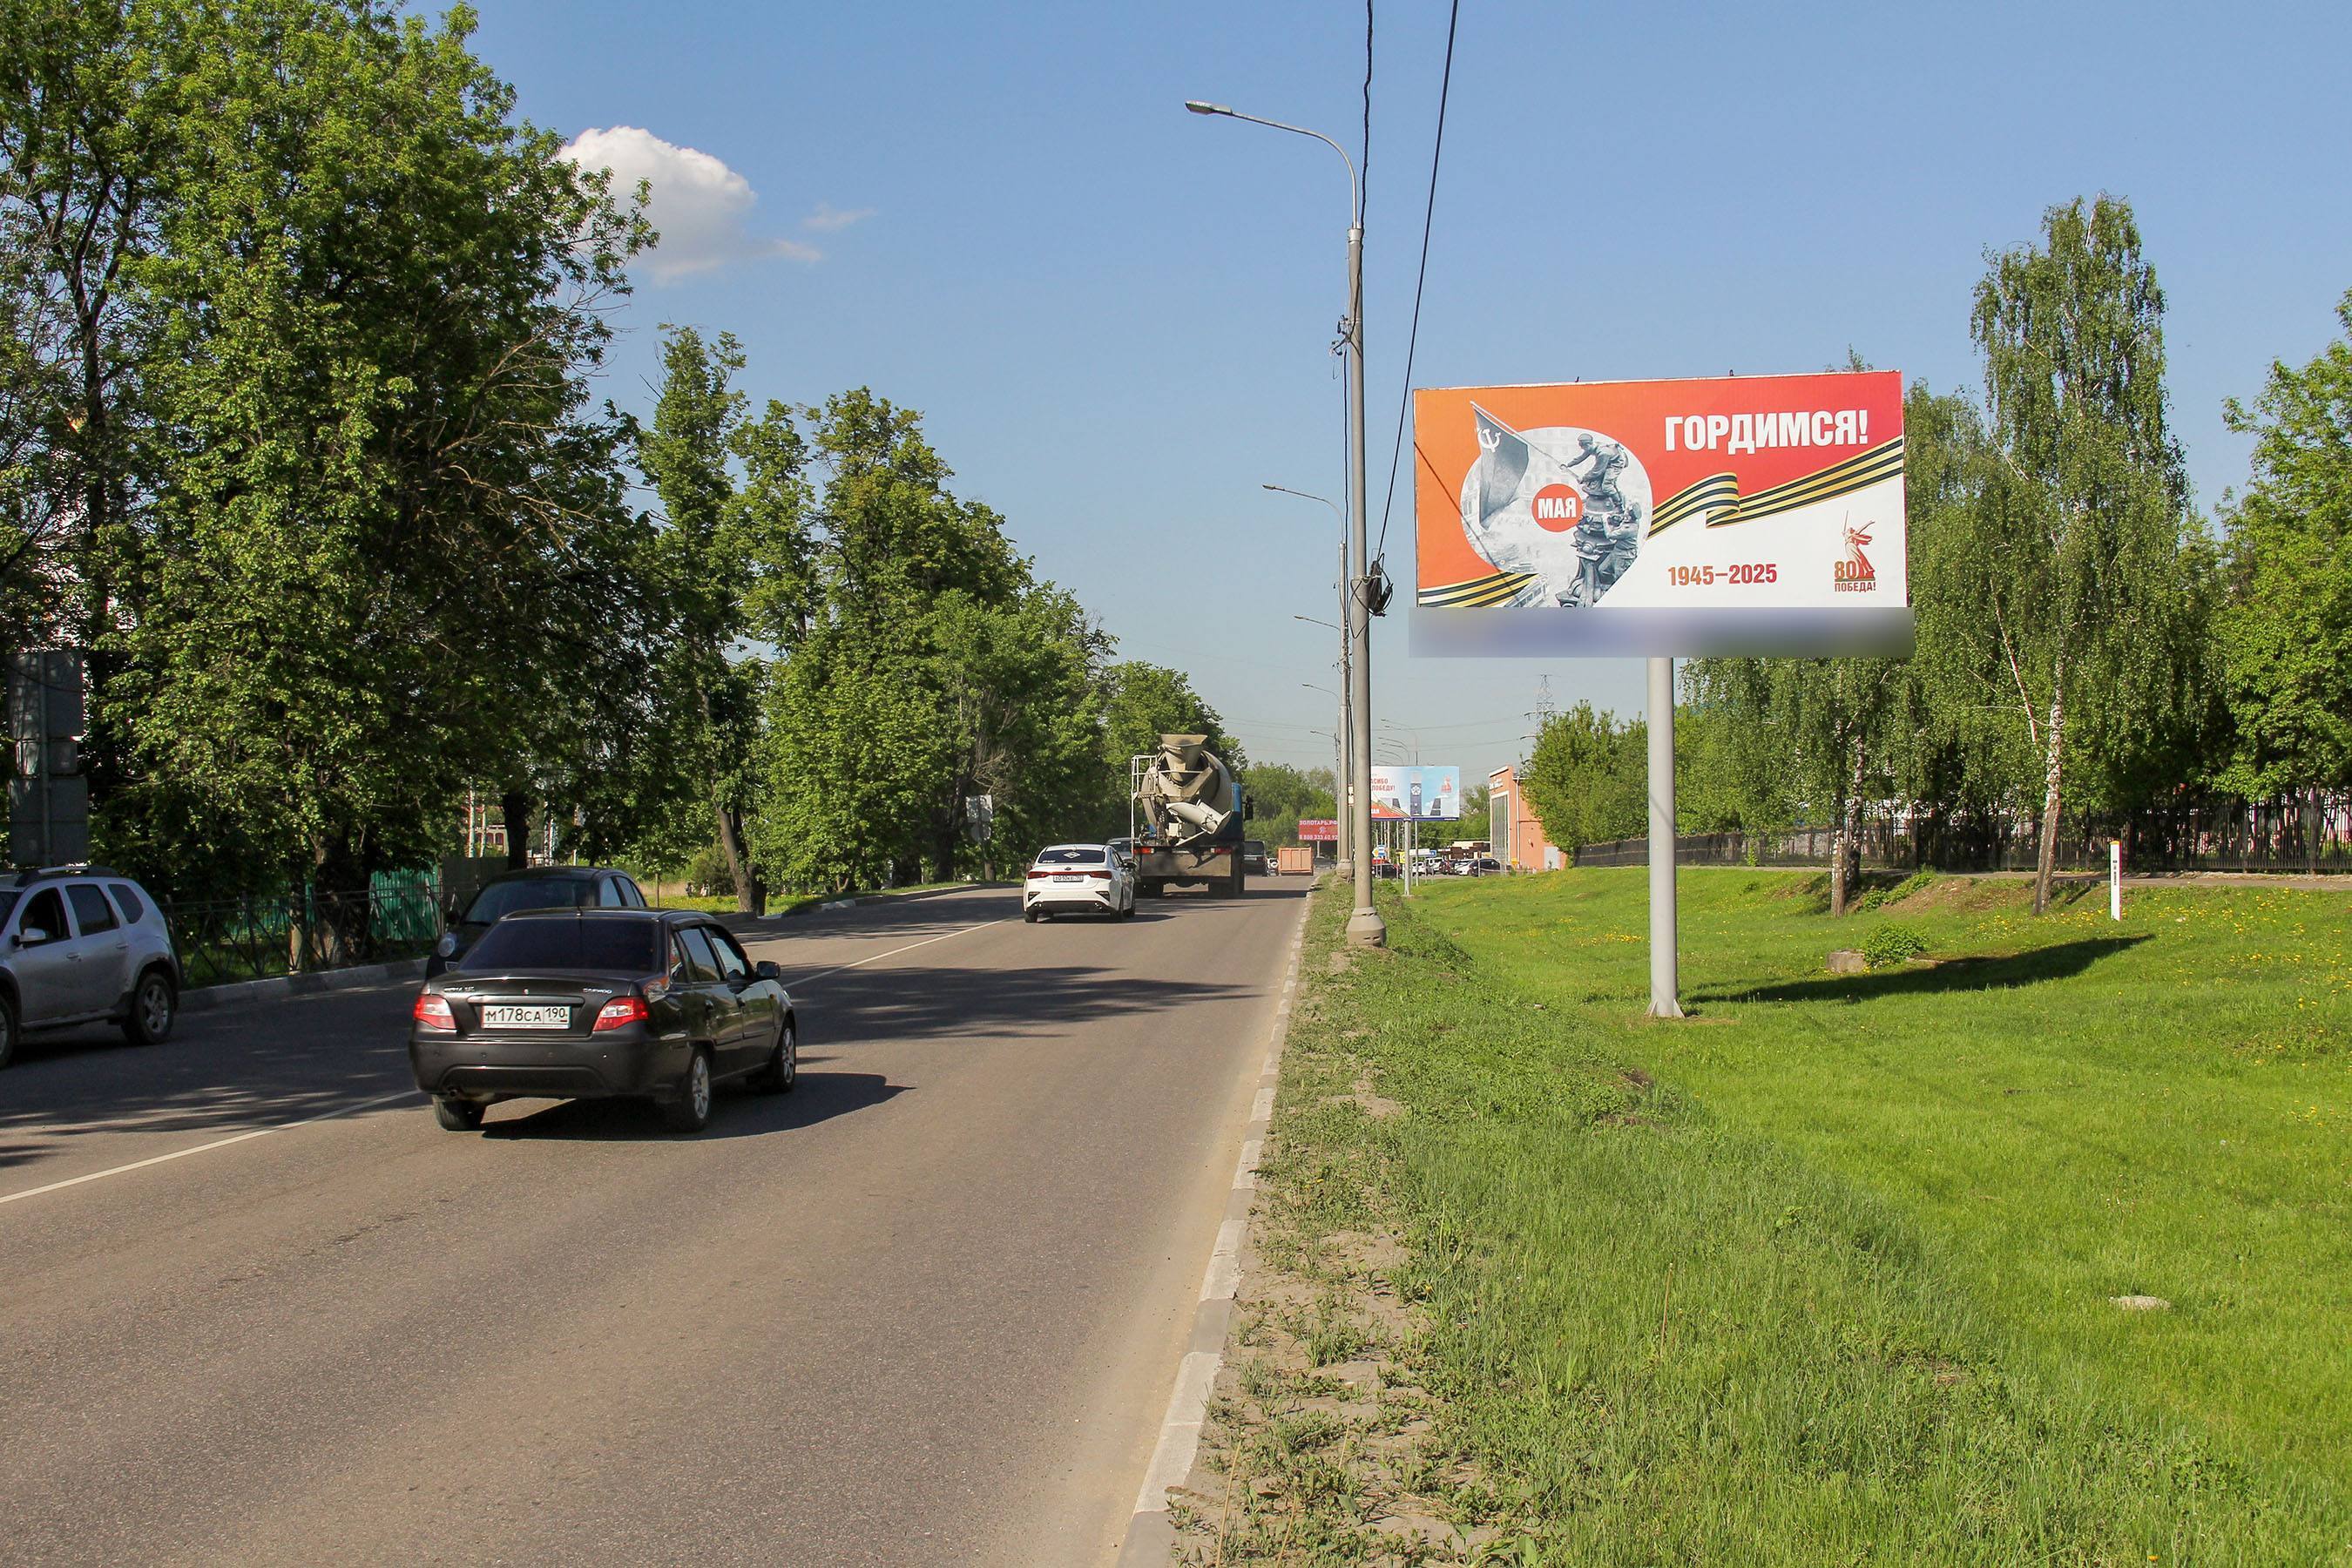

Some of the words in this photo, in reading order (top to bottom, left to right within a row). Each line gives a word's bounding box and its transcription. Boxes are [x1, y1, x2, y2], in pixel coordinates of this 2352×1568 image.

[1665, 409, 1869, 455] ГОРДИМСЯ!
[1538, 497, 1577, 519] МАЯ
[1667, 564, 1777, 585] 1945–2025
[1834, 560, 1857, 579] 80
[1834, 582, 1876, 592] ПОБЕДА!
[545, 1007, 565, 1018] 190
